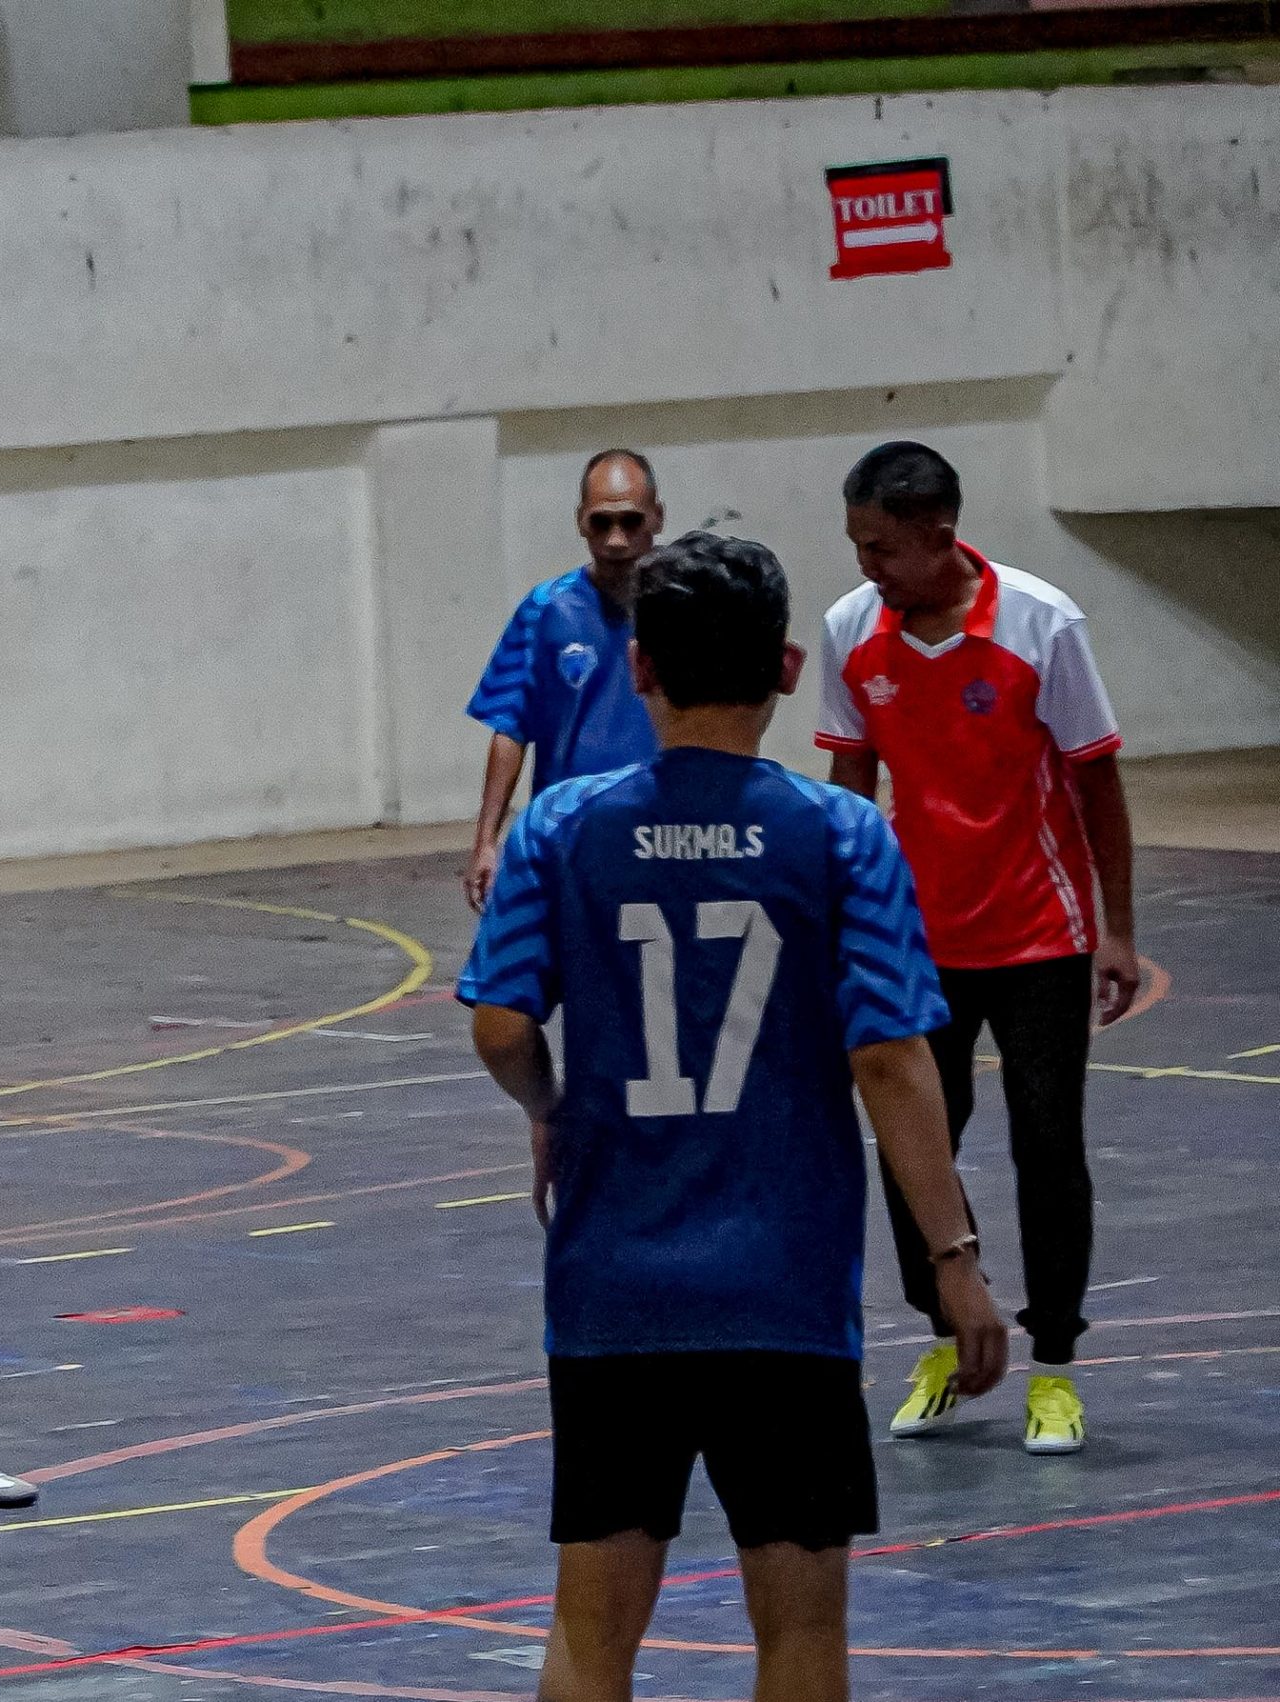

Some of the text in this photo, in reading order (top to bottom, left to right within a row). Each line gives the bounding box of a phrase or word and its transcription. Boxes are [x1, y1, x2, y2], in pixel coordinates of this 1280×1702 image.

[837, 190, 934, 222] TOILET
[633, 824, 764, 859] SUKMA.S
[618, 901, 783, 1117] 17
